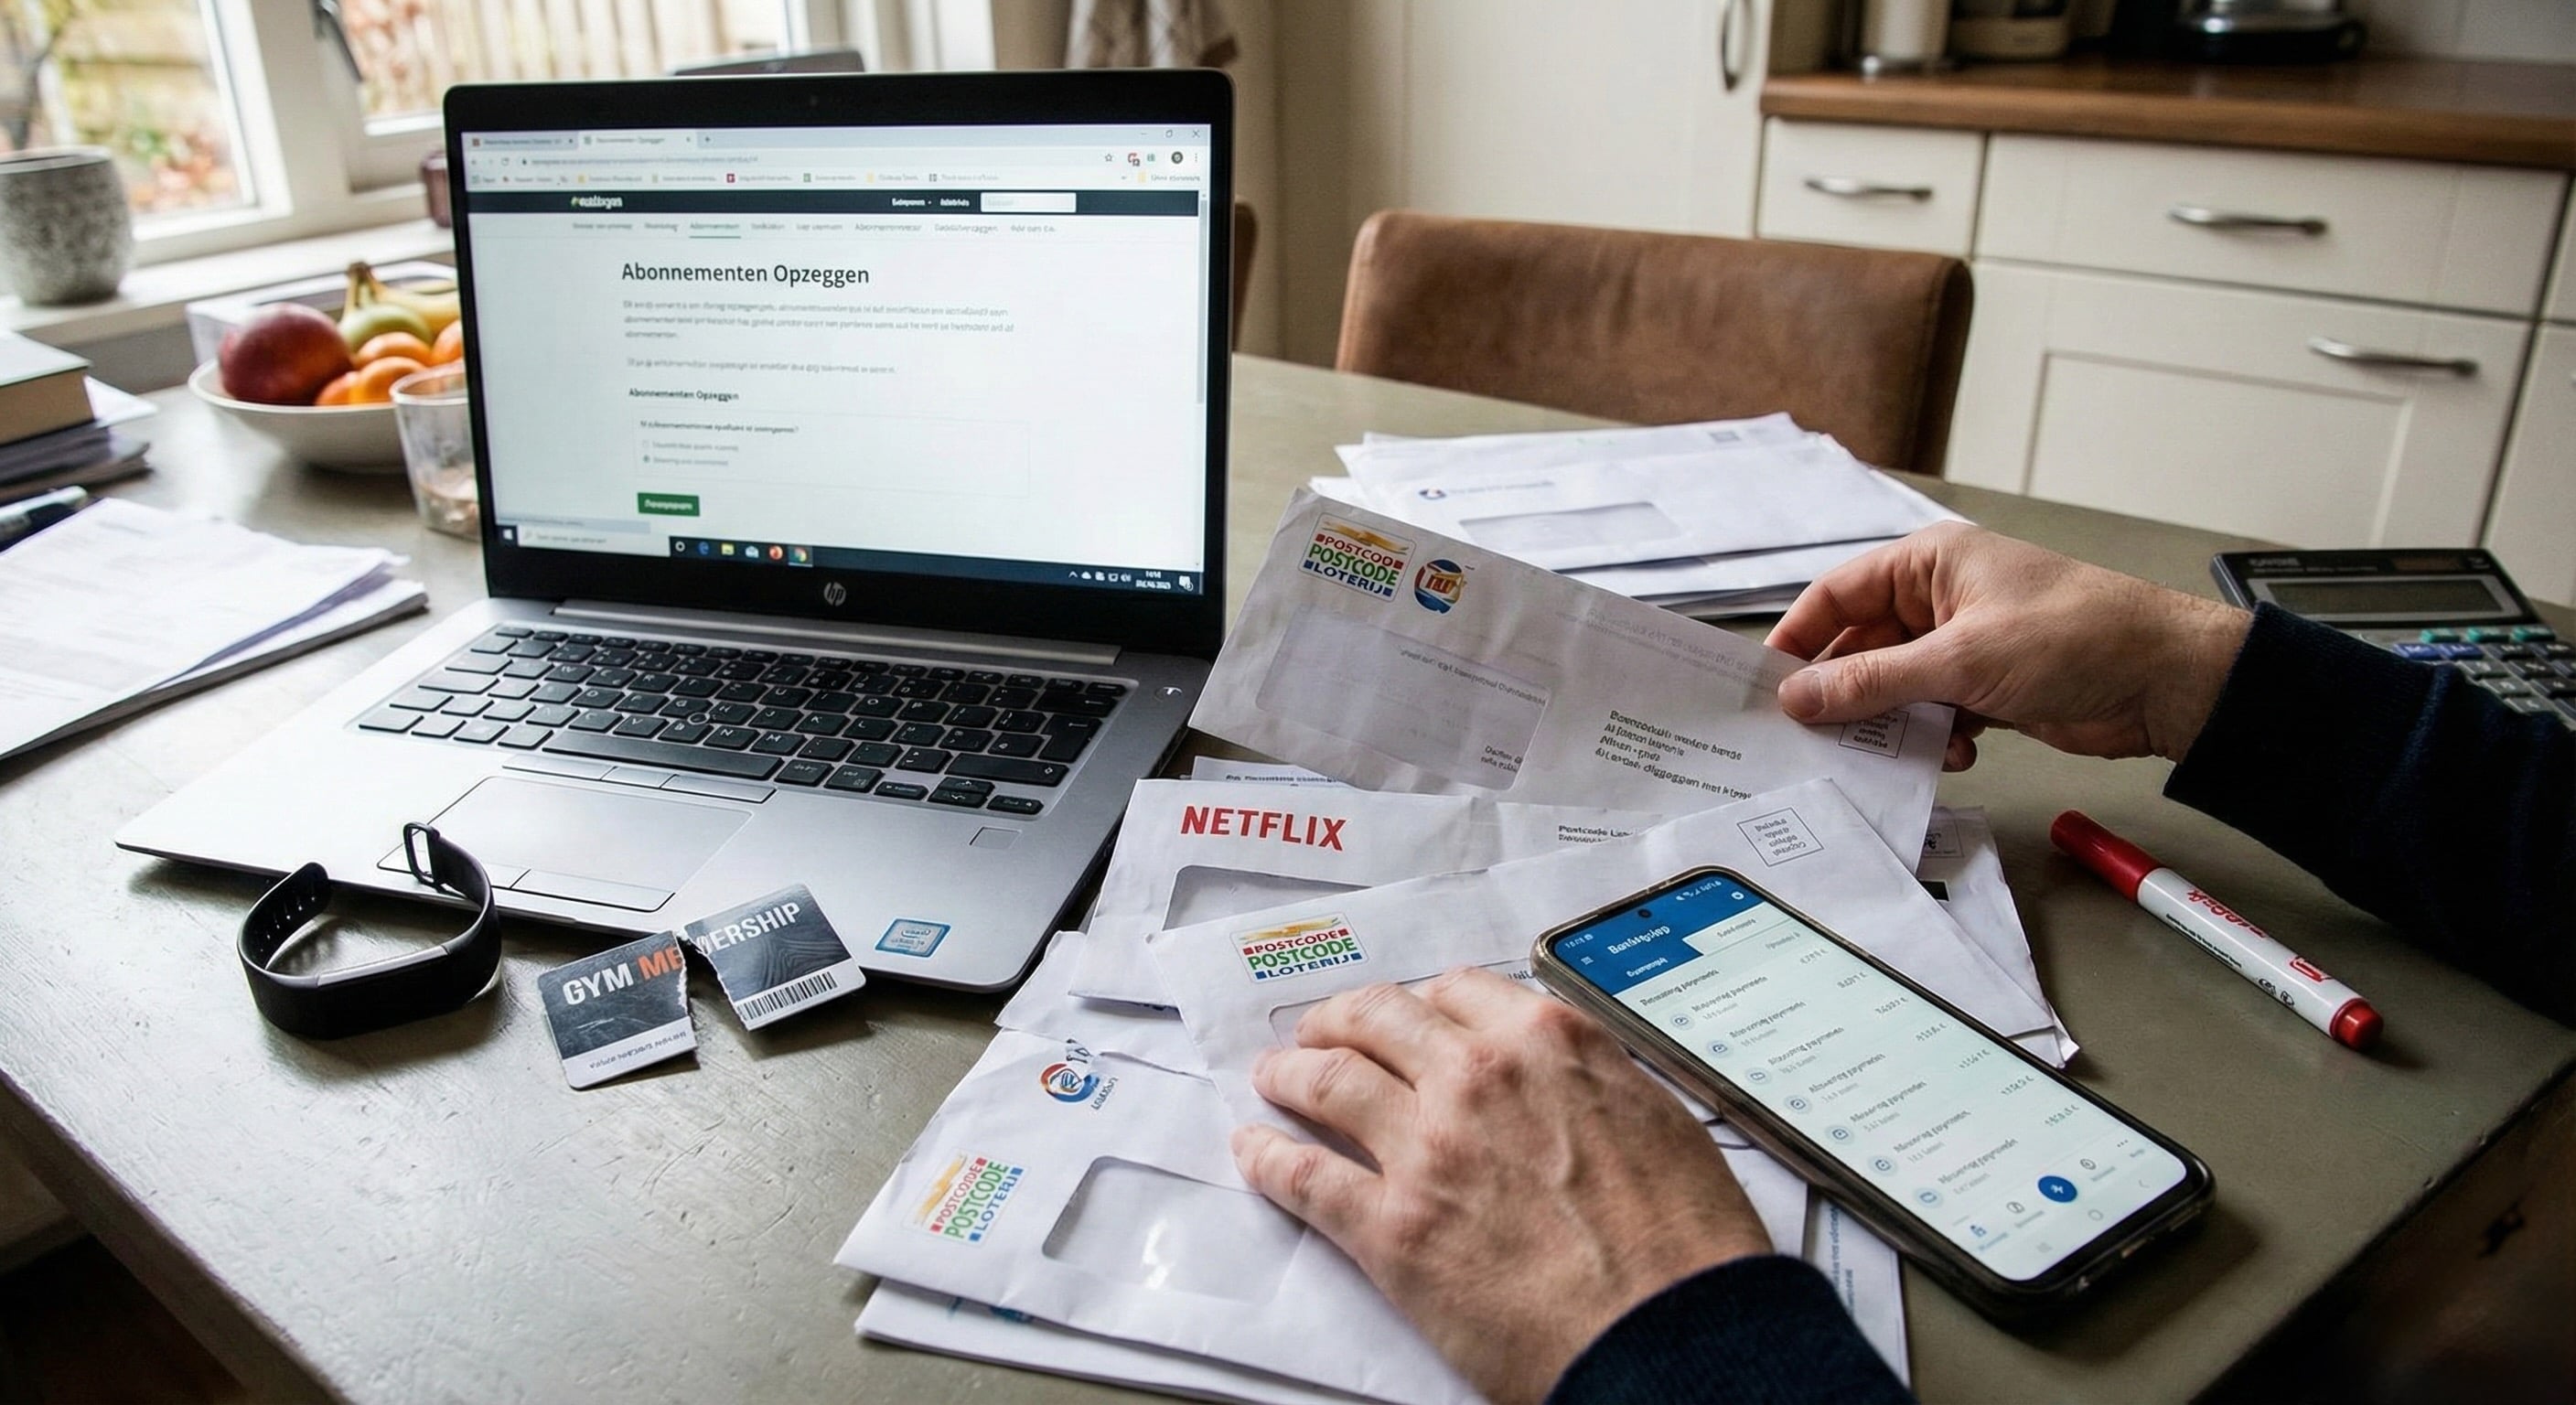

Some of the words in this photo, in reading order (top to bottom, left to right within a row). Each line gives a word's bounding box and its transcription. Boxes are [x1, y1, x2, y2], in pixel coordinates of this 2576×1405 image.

[622, 263, 768, 283] Abonnementen
[774, 264, 869, 288] Opzeggen
[1308, 542, 1401, 586] POSTCODE
[1181, 806, 1347, 852] NETFLIX
[1248, 937, 1358, 970] POSTCODE
[1254, 930, 1338, 953] POSTCODE
[563, 962, 634, 1006] GYM
[944, 1160, 1010, 1239] POSTCODE
